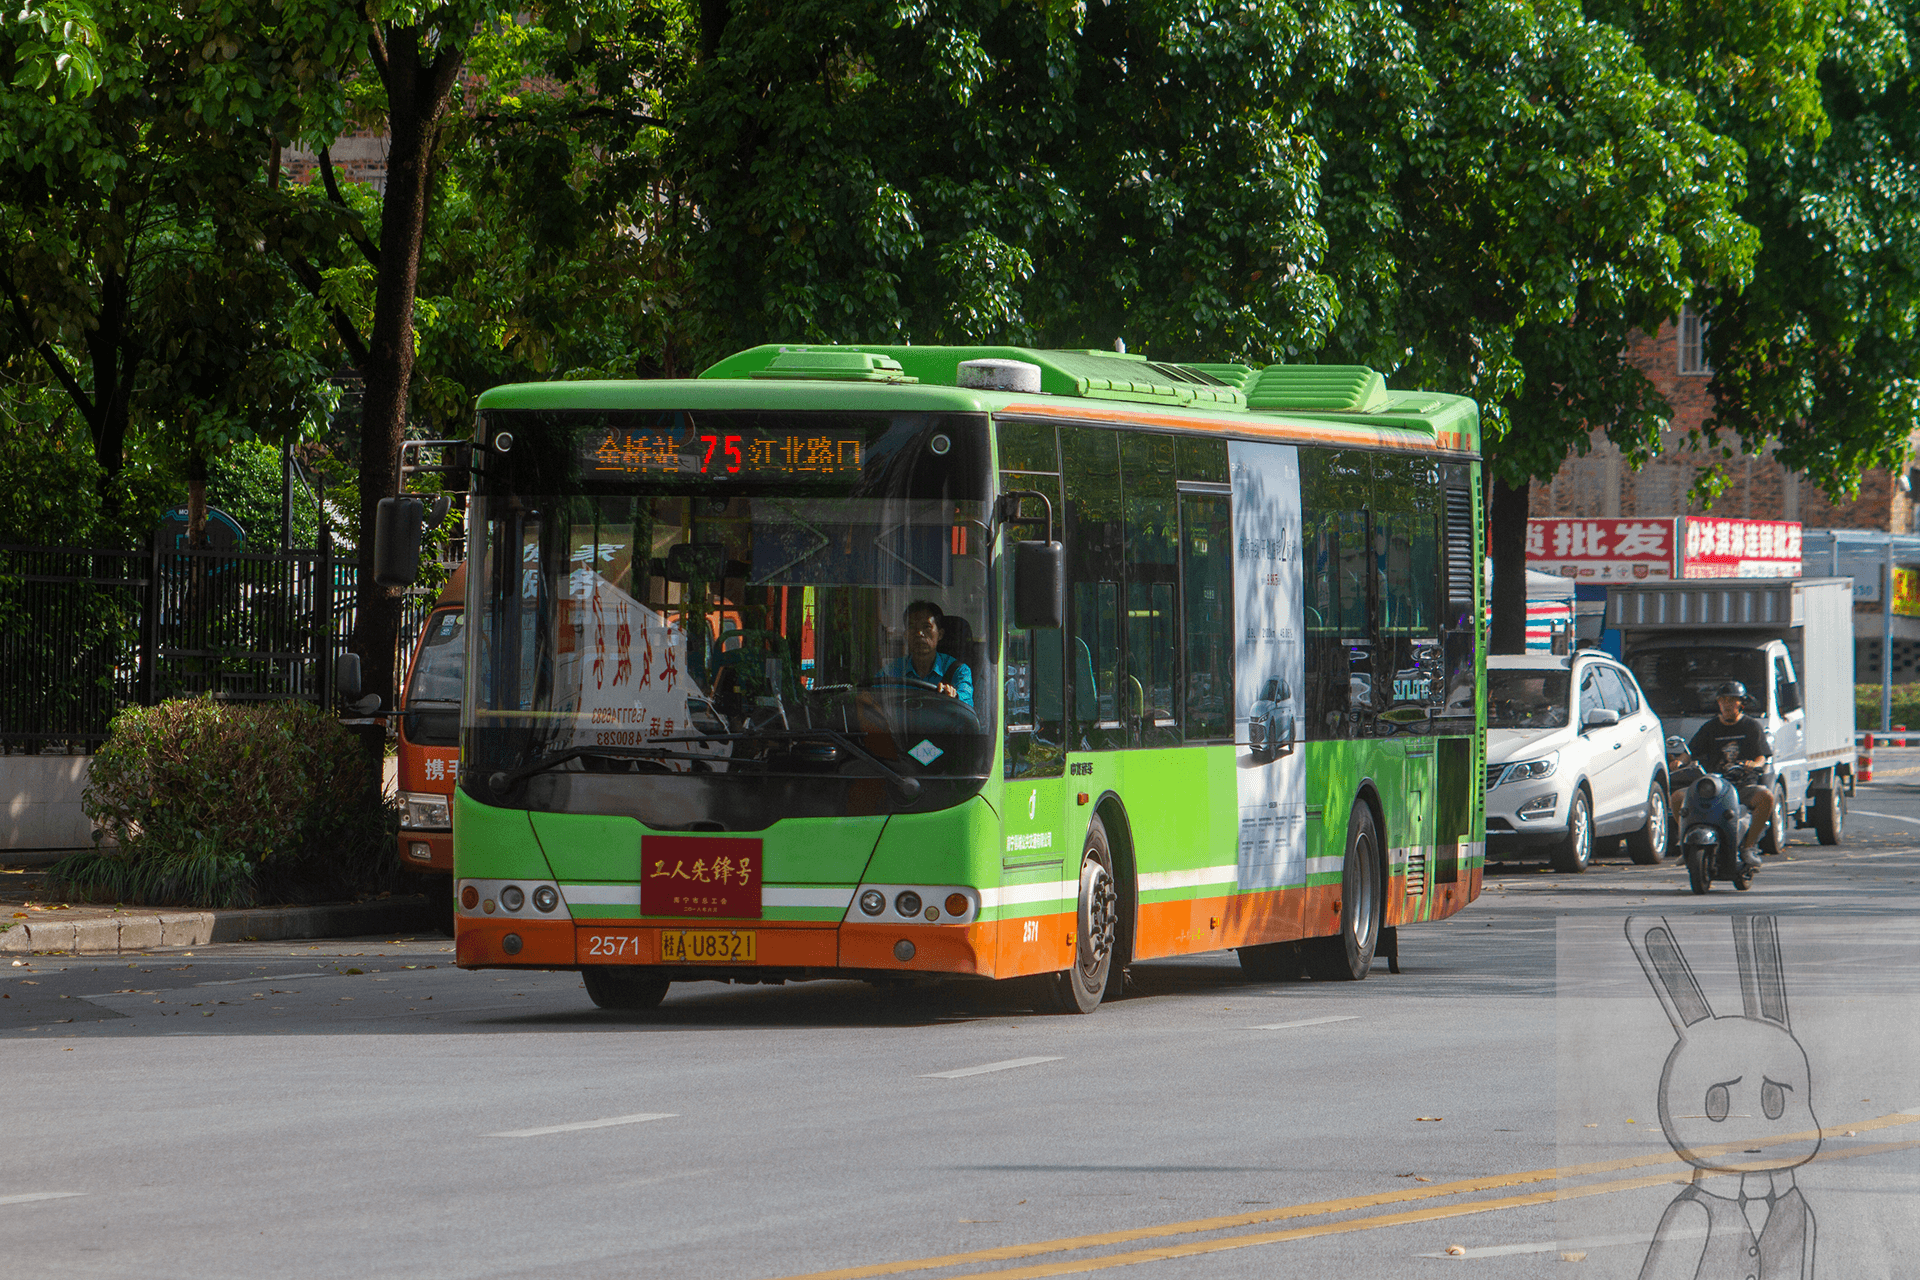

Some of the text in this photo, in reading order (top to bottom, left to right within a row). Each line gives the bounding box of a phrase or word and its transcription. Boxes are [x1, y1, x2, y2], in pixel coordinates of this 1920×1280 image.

[596, 436, 679, 473] 金桥站
[700, 435, 742, 473] 75
[916, 747, 937, 758] LNG
[650, 856, 752, 886] 工人先锋号
[1023, 920, 1039, 943] 2571
[589, 935, 639, 956] 2571
